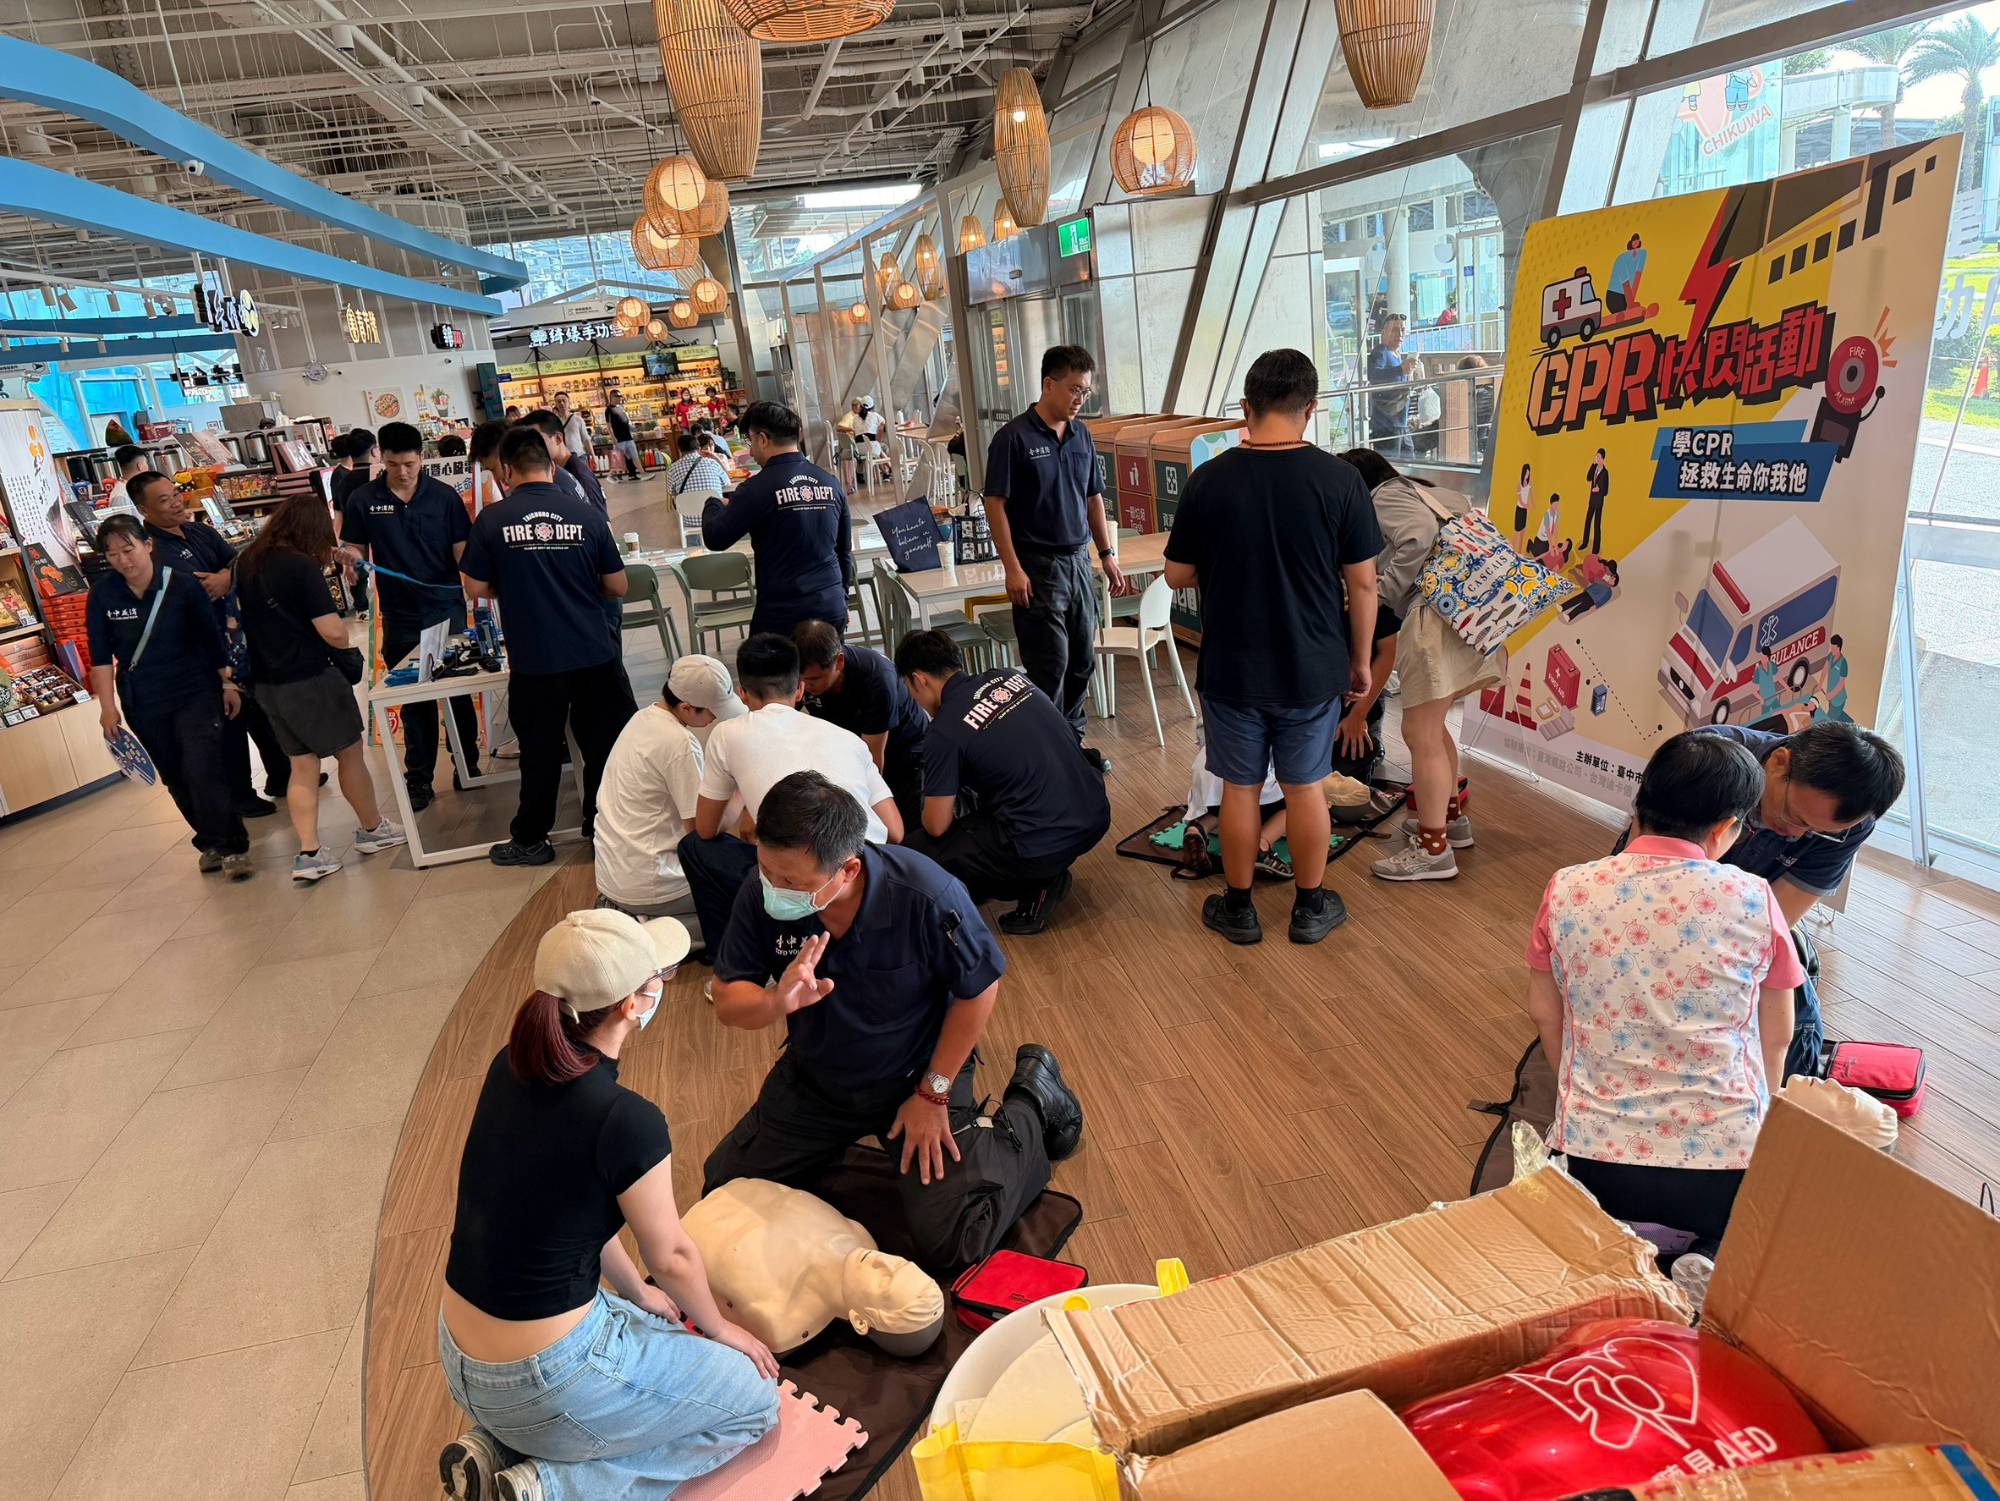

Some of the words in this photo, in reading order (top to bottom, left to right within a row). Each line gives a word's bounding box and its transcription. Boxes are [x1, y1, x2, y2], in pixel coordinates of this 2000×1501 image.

[1703, 104, 1771, 155] CHIKUWA
[1849, 345, 1867, 359] FIRE
[1672, 429, 1734, 458] 學CPR
[1679, 461, 1809, 494] 拯救生命你我他
[775, 487, 801, 505] FIRE
[813, 486, 836, 501] DEPT.
[550, 512, 564, 522] CITY
[502, 524, 534, 543] FIRE
[555, 524, 586, 541] DEPT.
[1467, 555, 1507, 592] CASCAIS
[963, 698, 999, 730] FIRE
